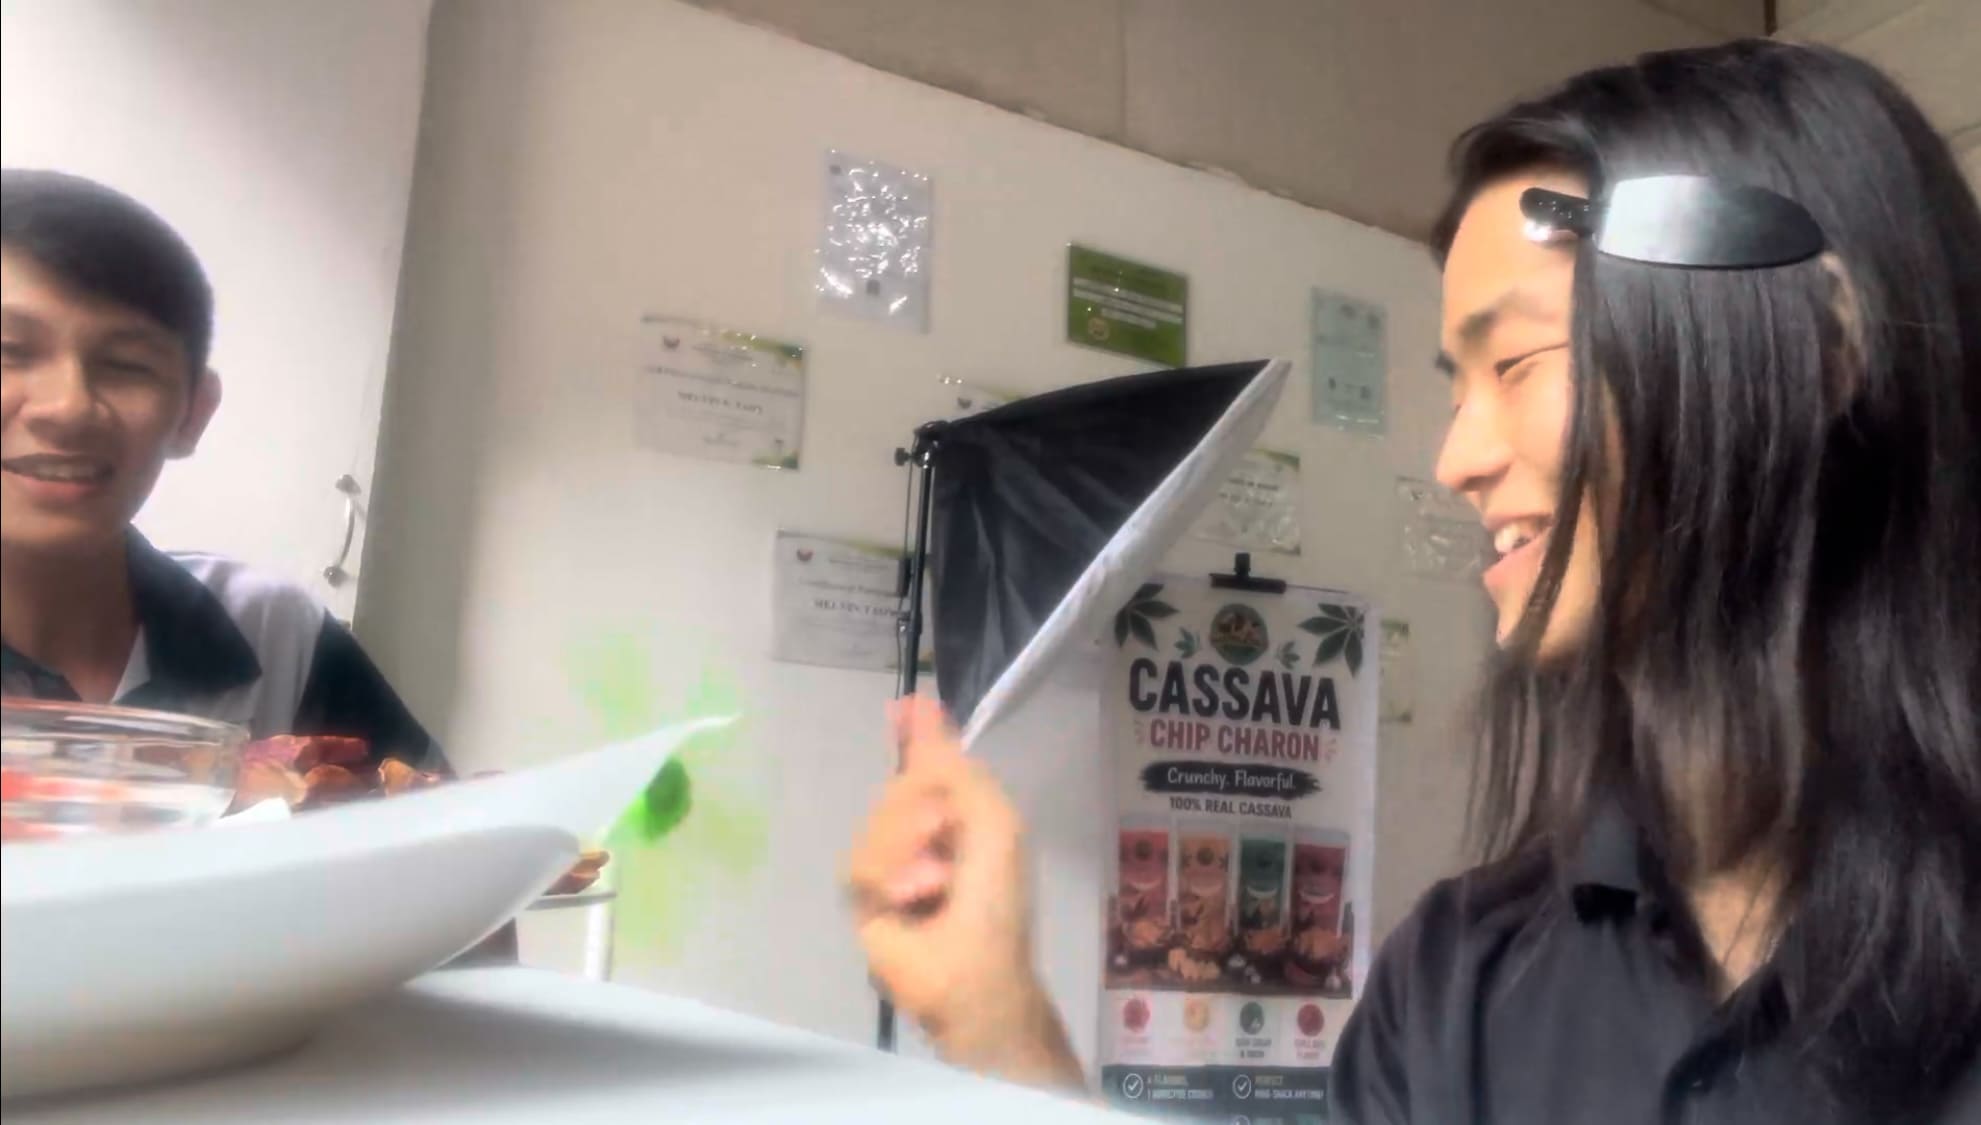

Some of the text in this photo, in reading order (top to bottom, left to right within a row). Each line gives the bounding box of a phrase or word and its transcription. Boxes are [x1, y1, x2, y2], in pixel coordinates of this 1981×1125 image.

[1129, 658, 1341, 730] CASSAVA
[1151, 719, 1319, 761] CHIP CHARON
[1167, 767, 1296, 790] Crunchy. Flavorful.
[1169, 797, 1292, 818] 100% REAL CASSAVA
